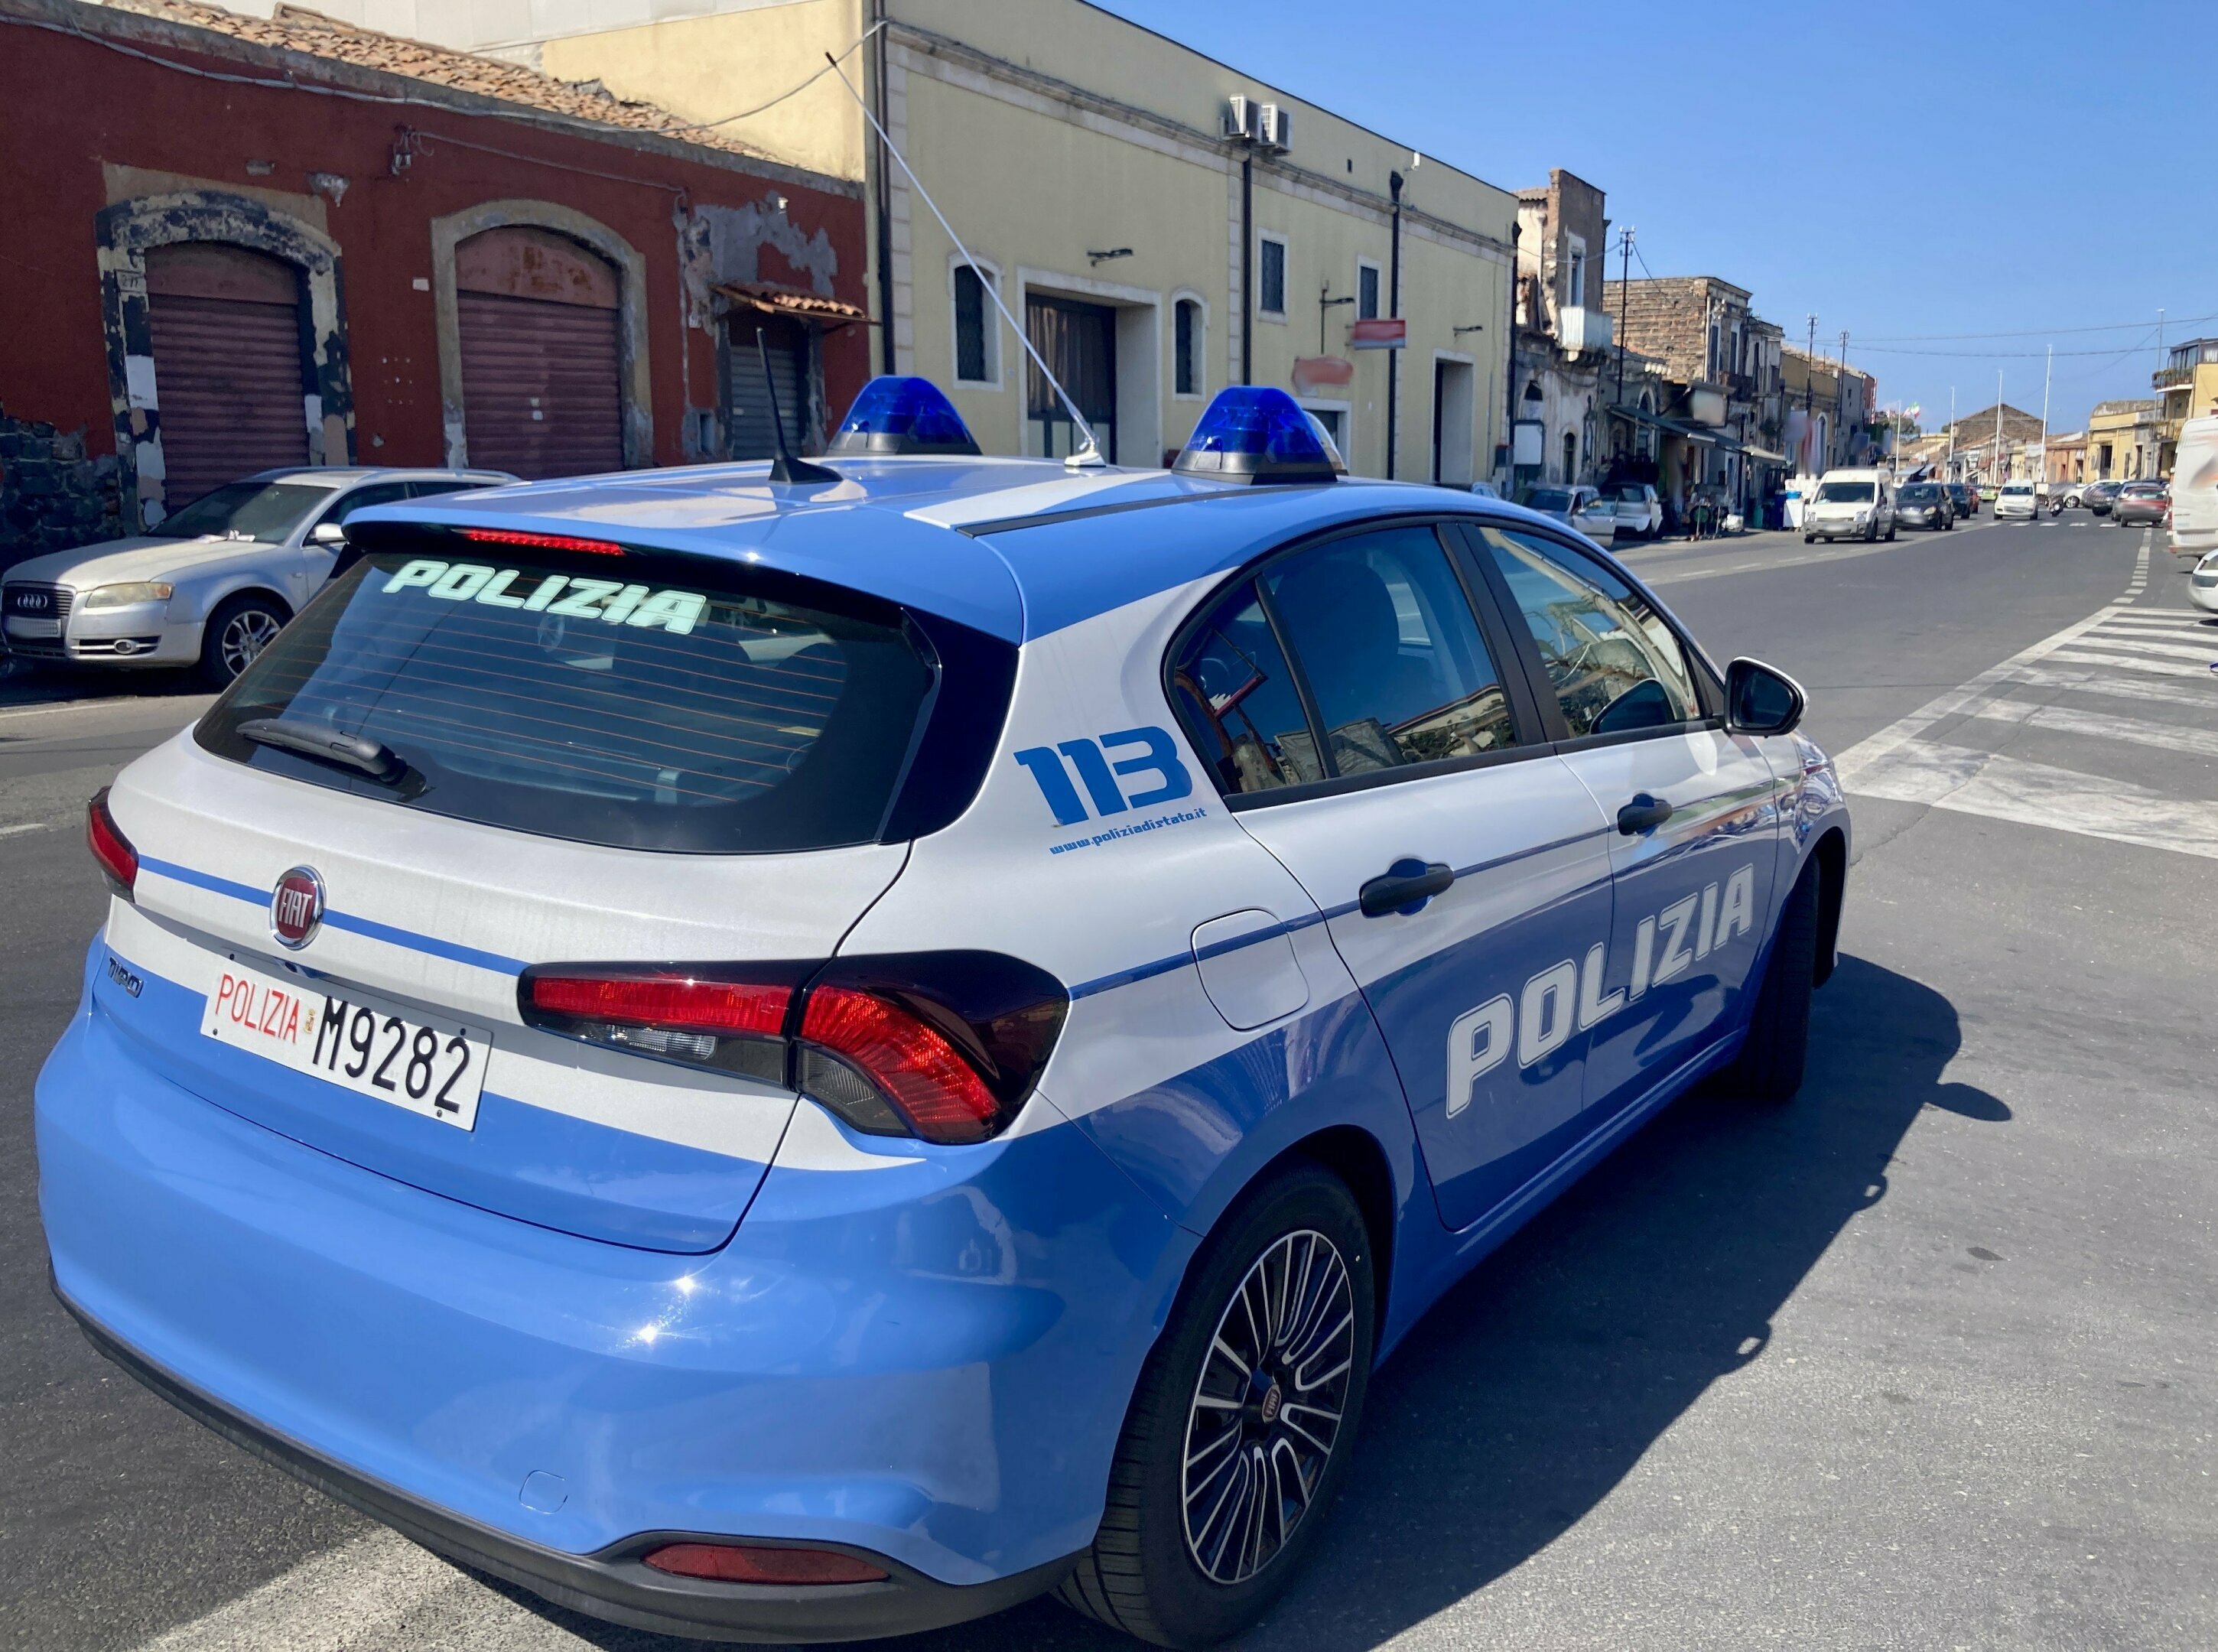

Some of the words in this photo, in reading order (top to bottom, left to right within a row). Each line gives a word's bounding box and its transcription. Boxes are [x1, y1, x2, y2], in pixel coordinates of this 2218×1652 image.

[382, 560, 707, 635] POLIZIA
[1013, 726, 1193, 826] 113
[1049, 808, 1208, 855] www.poliziadistato.it
[278, 887, 313, 928] FIAT
[1446, 863, 1754, 1119] POLIZIA
[216, 973, 299, 1043] POLIZIA
[313, 996, 470, 1113] M9282
